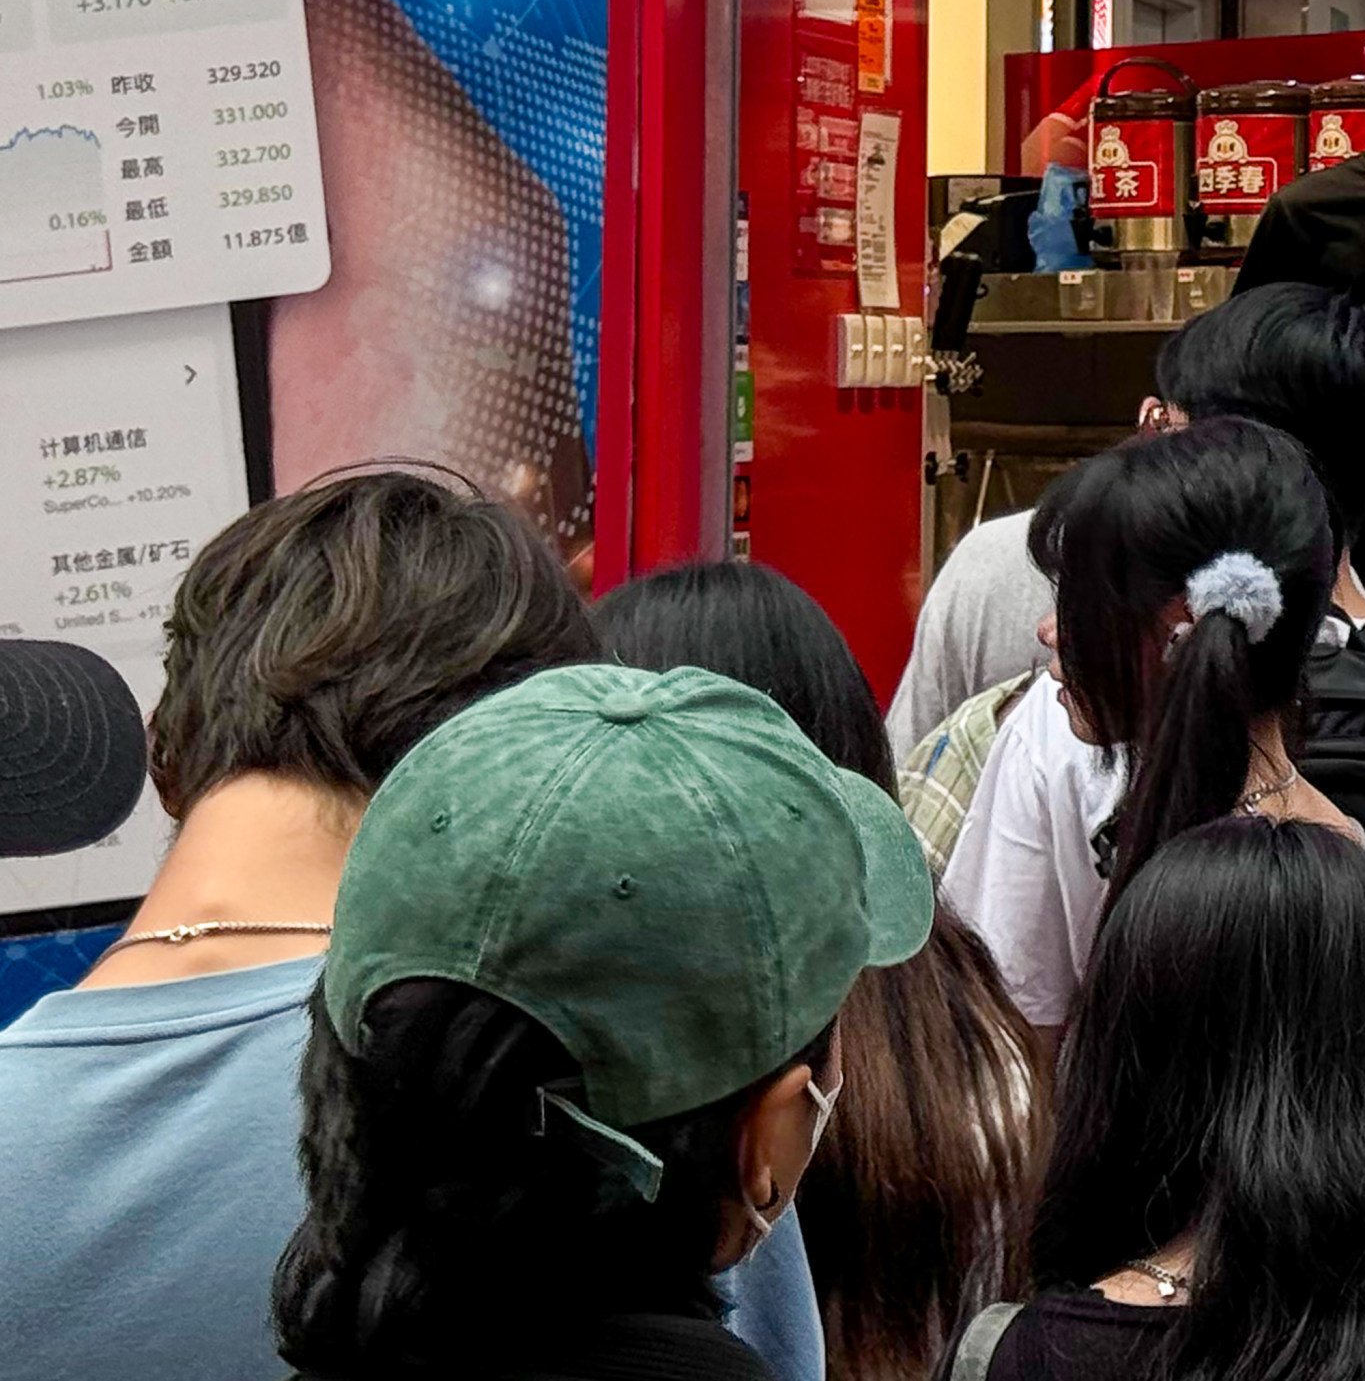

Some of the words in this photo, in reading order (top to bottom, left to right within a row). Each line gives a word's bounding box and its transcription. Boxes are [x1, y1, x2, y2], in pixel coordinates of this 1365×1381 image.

[38, 80, 94, 100] 1.03%
[111, 74, 156, 94] 昨收
[207, 60, 281, 84] 329.320
[116, 114, 160, 138] 今開
[214, 101, 288, 125] 331.000
[121, 156, 164, 180] 最高
[217, 143, 292, 168] 332.700
[126, 197, 169, 221] 最低
[219, 184, 293, 208] 329.850
[49, 210, 107, 231] 0.16%
[128, 239, 174, 263] 金額
[224, 222, 309, 250] 11.875億
[40, 427, 148, 459] 计算机通信
[43, 465, 121, 488] +2.87%
[52, 539, 190, 576] 其他金属/矿石
[54, 581, 132, 606] +2.61%
